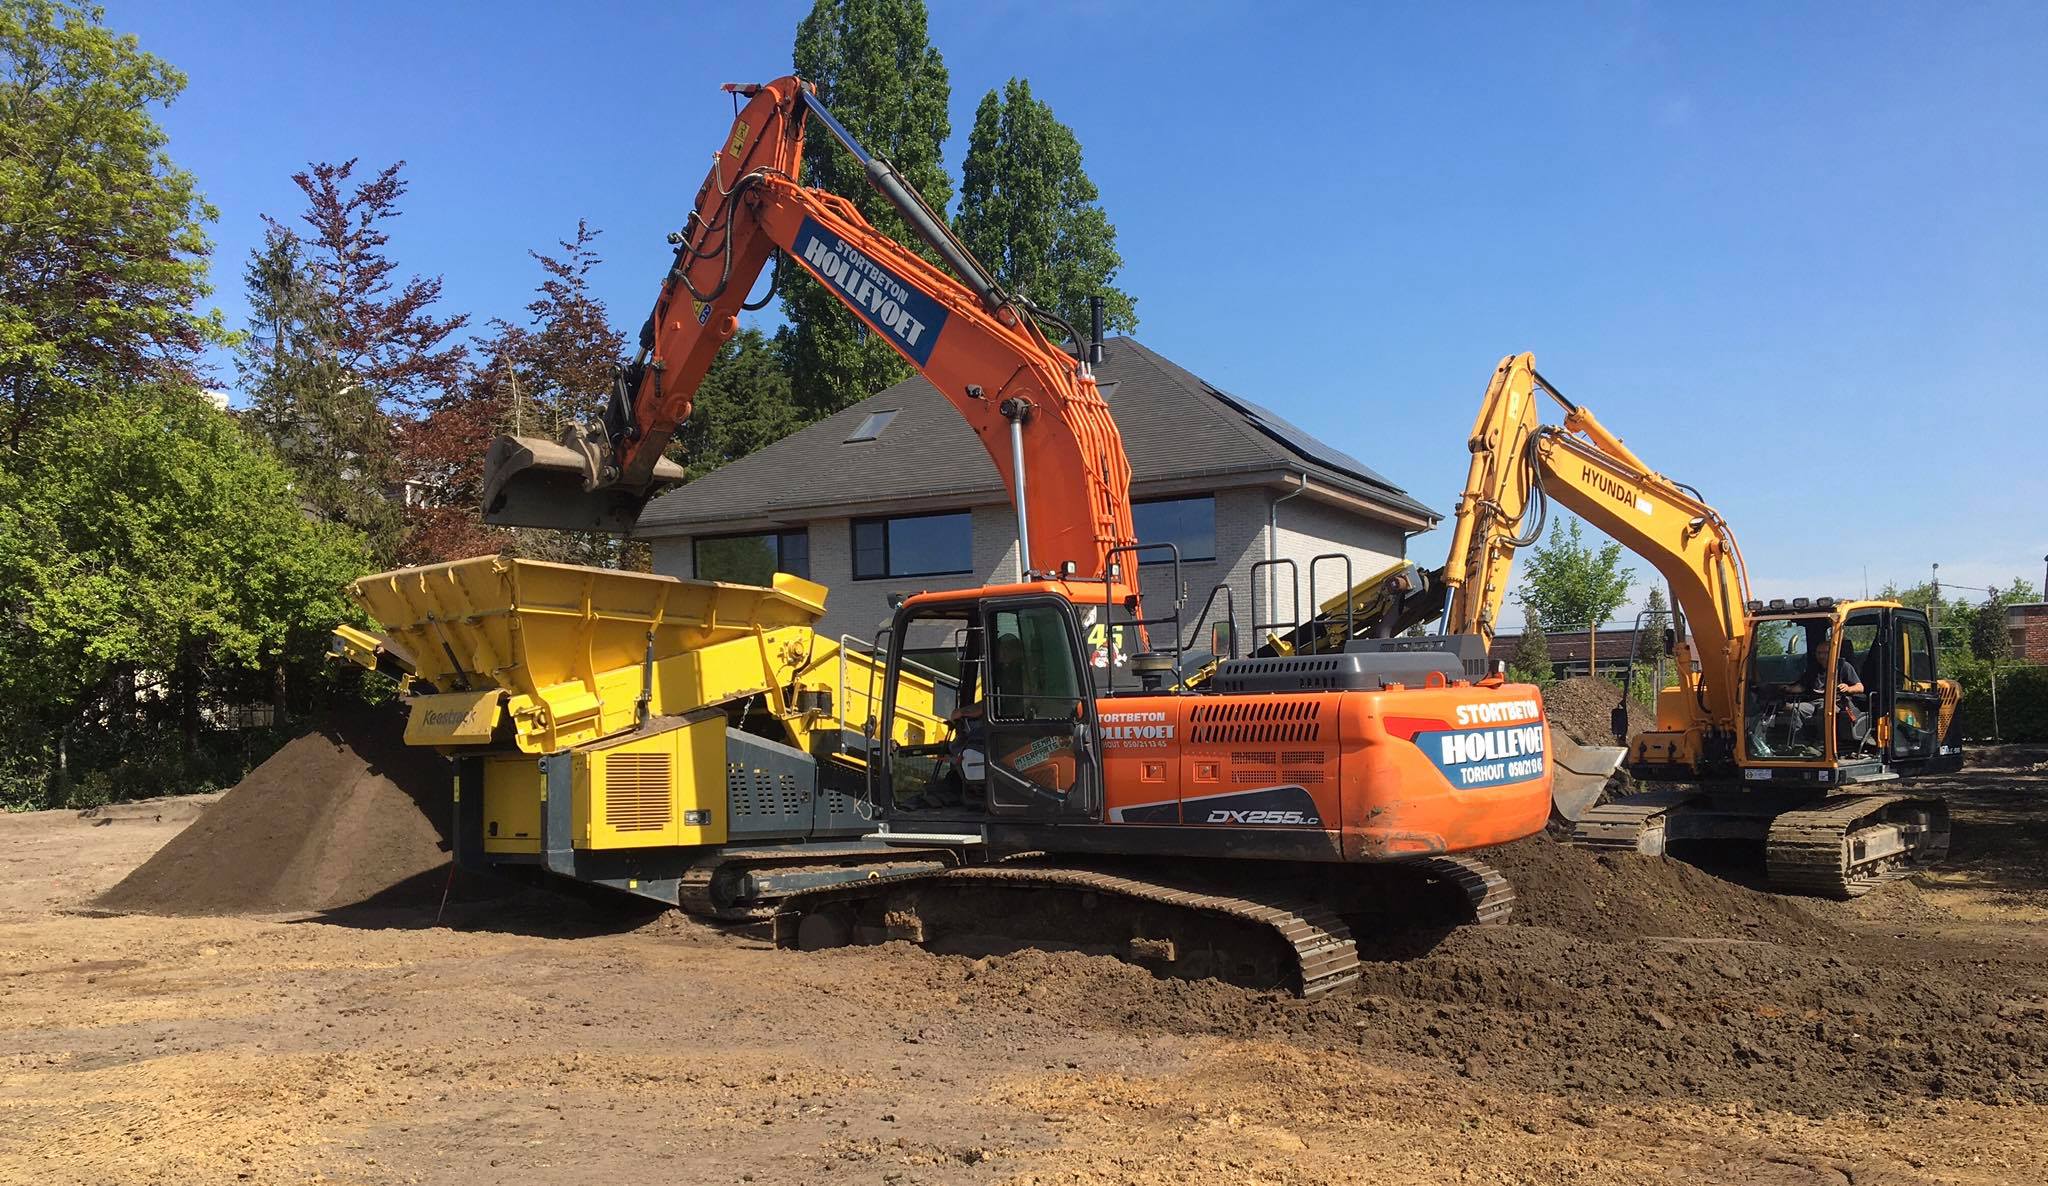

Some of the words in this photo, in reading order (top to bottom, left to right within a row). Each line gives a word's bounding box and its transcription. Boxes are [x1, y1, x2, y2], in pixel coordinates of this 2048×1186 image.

[835, 239, 909, 305] STORTBETON
[803, 235, 926, 347] HOLLEVOET
[1582, 465, 1637, 509] HYUNDAI
[1098, 711, 1166, 723] TORTBETON
[1456, 700, 1539, 725] STORTBETON
[1099, 725, 1175, 740] OLLEVOET
[1461, 763, 1505, 784] TORHOUT
